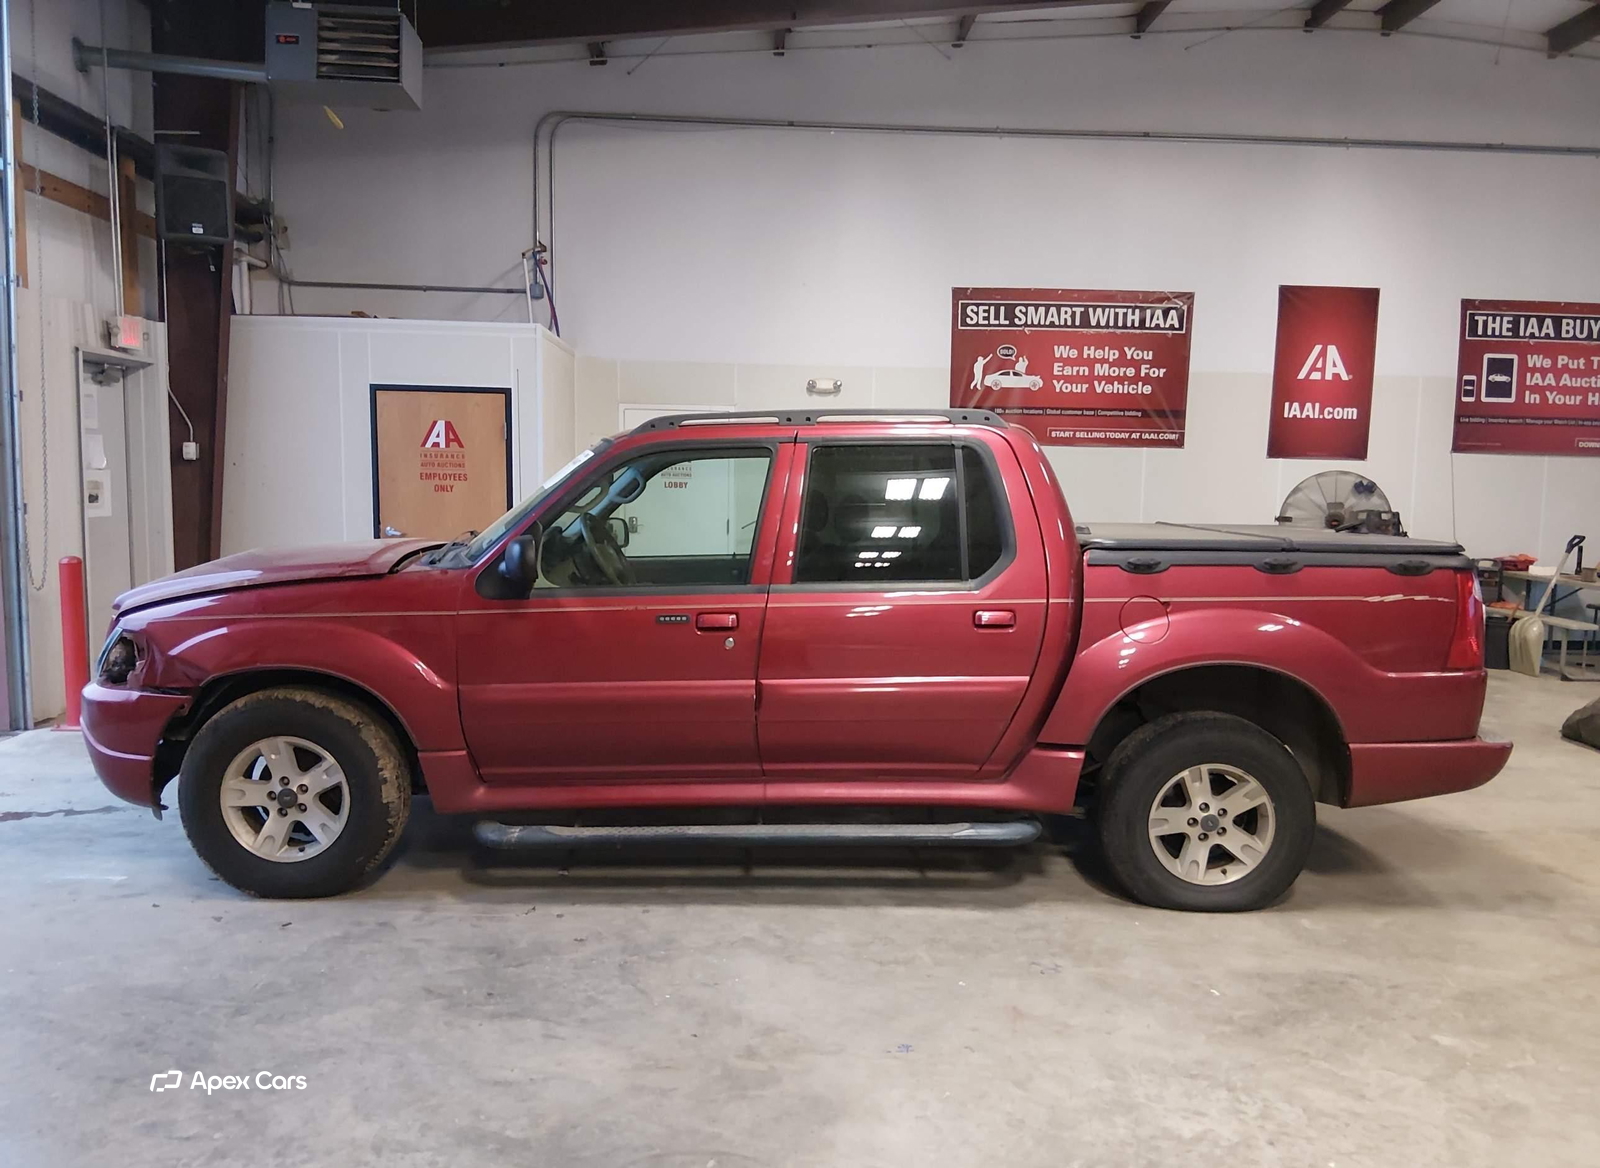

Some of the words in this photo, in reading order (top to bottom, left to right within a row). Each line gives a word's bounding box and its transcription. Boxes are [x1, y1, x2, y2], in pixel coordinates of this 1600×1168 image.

[965, 305, 1010, 325] SELL
[1014, 306, 1084, 326] SMART
[1089, 307, 1140, 328] WITH
[1145, 309, 1179, 328] IAA
[1474, 315, 1514, 336] THE
[1519, 317, 1555, 338] IAA
[1053, 345, 1078, 358] We
[1083, 346, 1119, 362] Help
[1124, 347, 1153, 360] You
[1526, 354, 1552, 368] We
[1557, 355, 1586, 369] Put
[1053, 362, 1089, 376] Earn
[1094, 363, 1136, 376] More
[1140, 364, 1166, 378] For
[1525, 372, 1556, 386] IAA
[1052, 380, 1089, 393] Your
[1093, 380, 1152, 394] Vehicle
[1524, 390, 1540, 404] In
[1545, 391, 1582, 405] Your
[1587, 392, 1600, 406] H
[1283, 402, 1358, 420] IAAI.com
[420, 472, 468, 481] EMPLOYEES
[434, 484, 454, 492] ONLY
[664, 481, 688, 489] LOBBY
